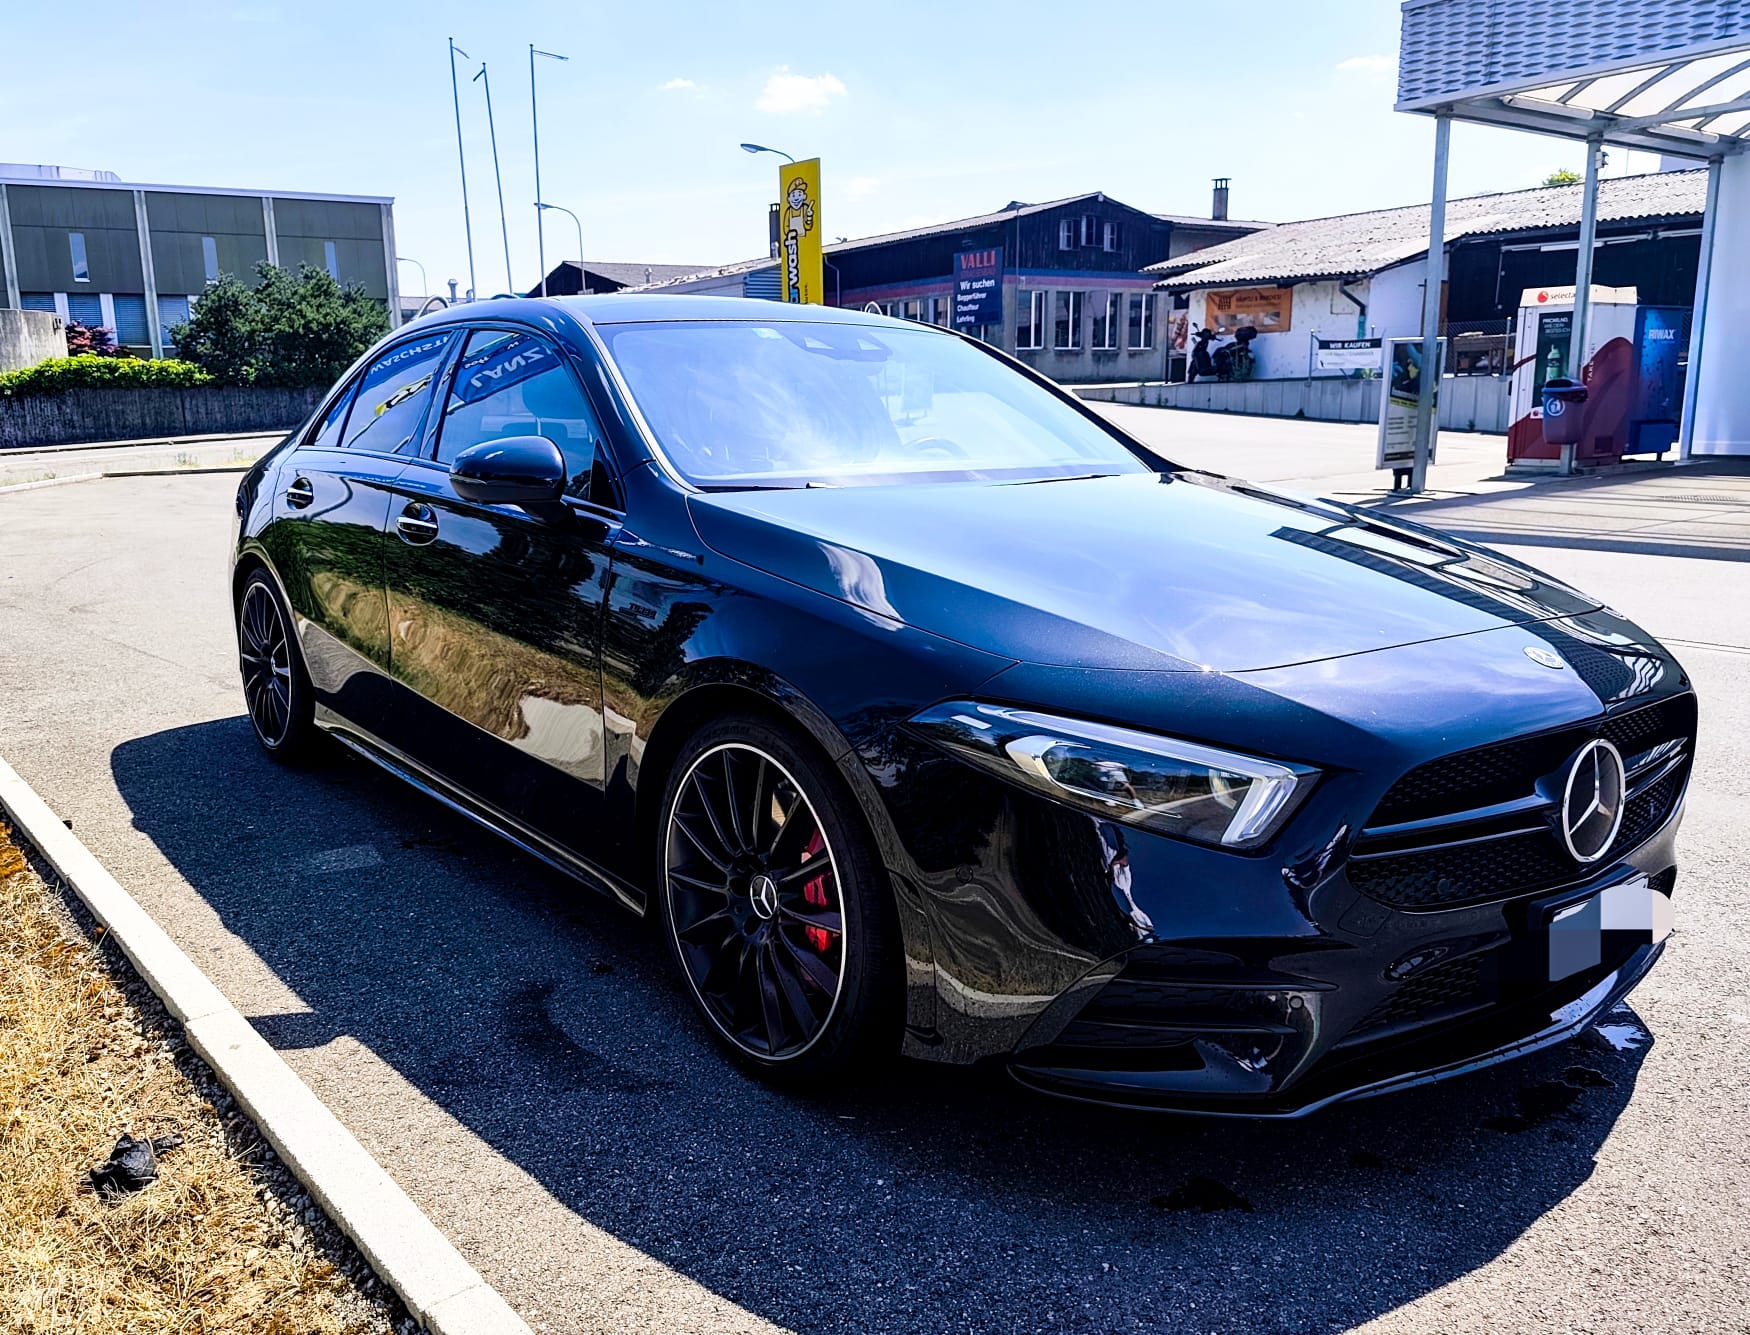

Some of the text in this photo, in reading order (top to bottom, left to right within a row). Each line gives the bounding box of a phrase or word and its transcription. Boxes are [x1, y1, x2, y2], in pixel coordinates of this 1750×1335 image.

[960, 250, 996, 270] VALLI
[960, 278, 995, 291] Wir suchen
[957, 304, 980, 312] Chauffeur
[956, 315, 976, 324] Lehrling
[1648, 329, 1676, 340] RIWAX
